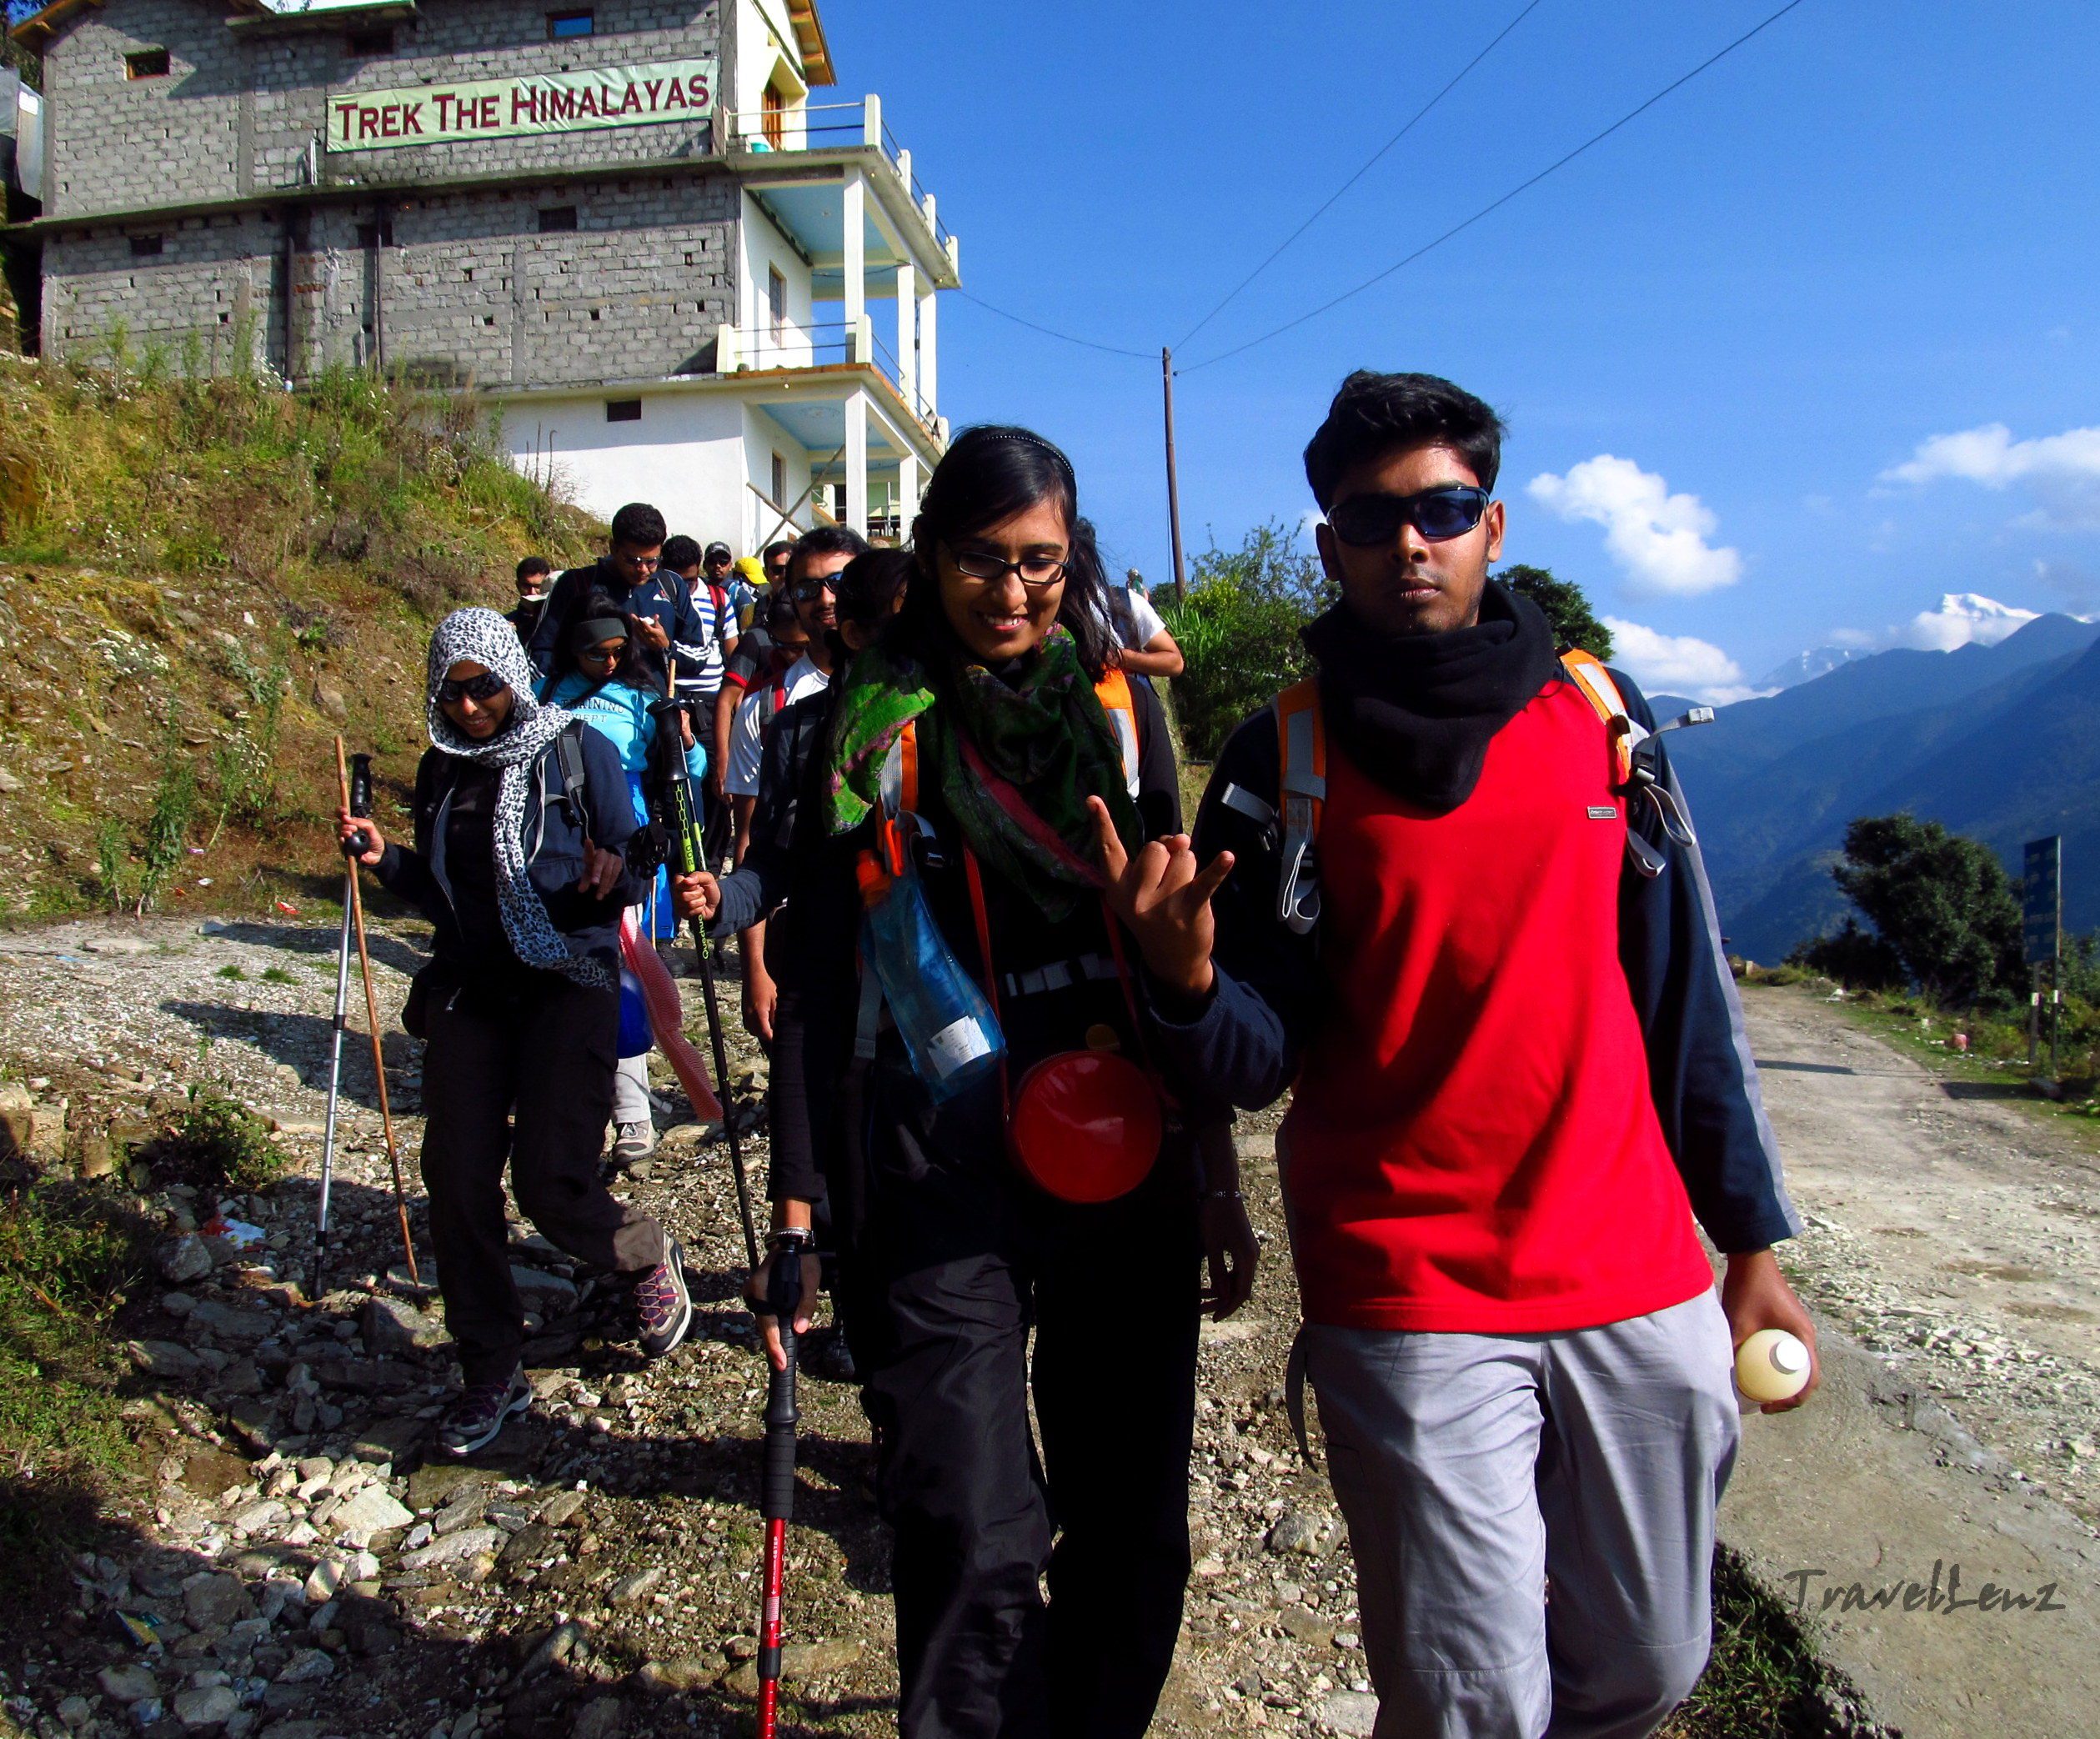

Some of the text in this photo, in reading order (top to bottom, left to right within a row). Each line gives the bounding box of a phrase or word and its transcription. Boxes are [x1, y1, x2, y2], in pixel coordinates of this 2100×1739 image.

[335, 75, 709, 141] TREK THE HIMALAYAS
[698, 914, 709, 960] Quechua
